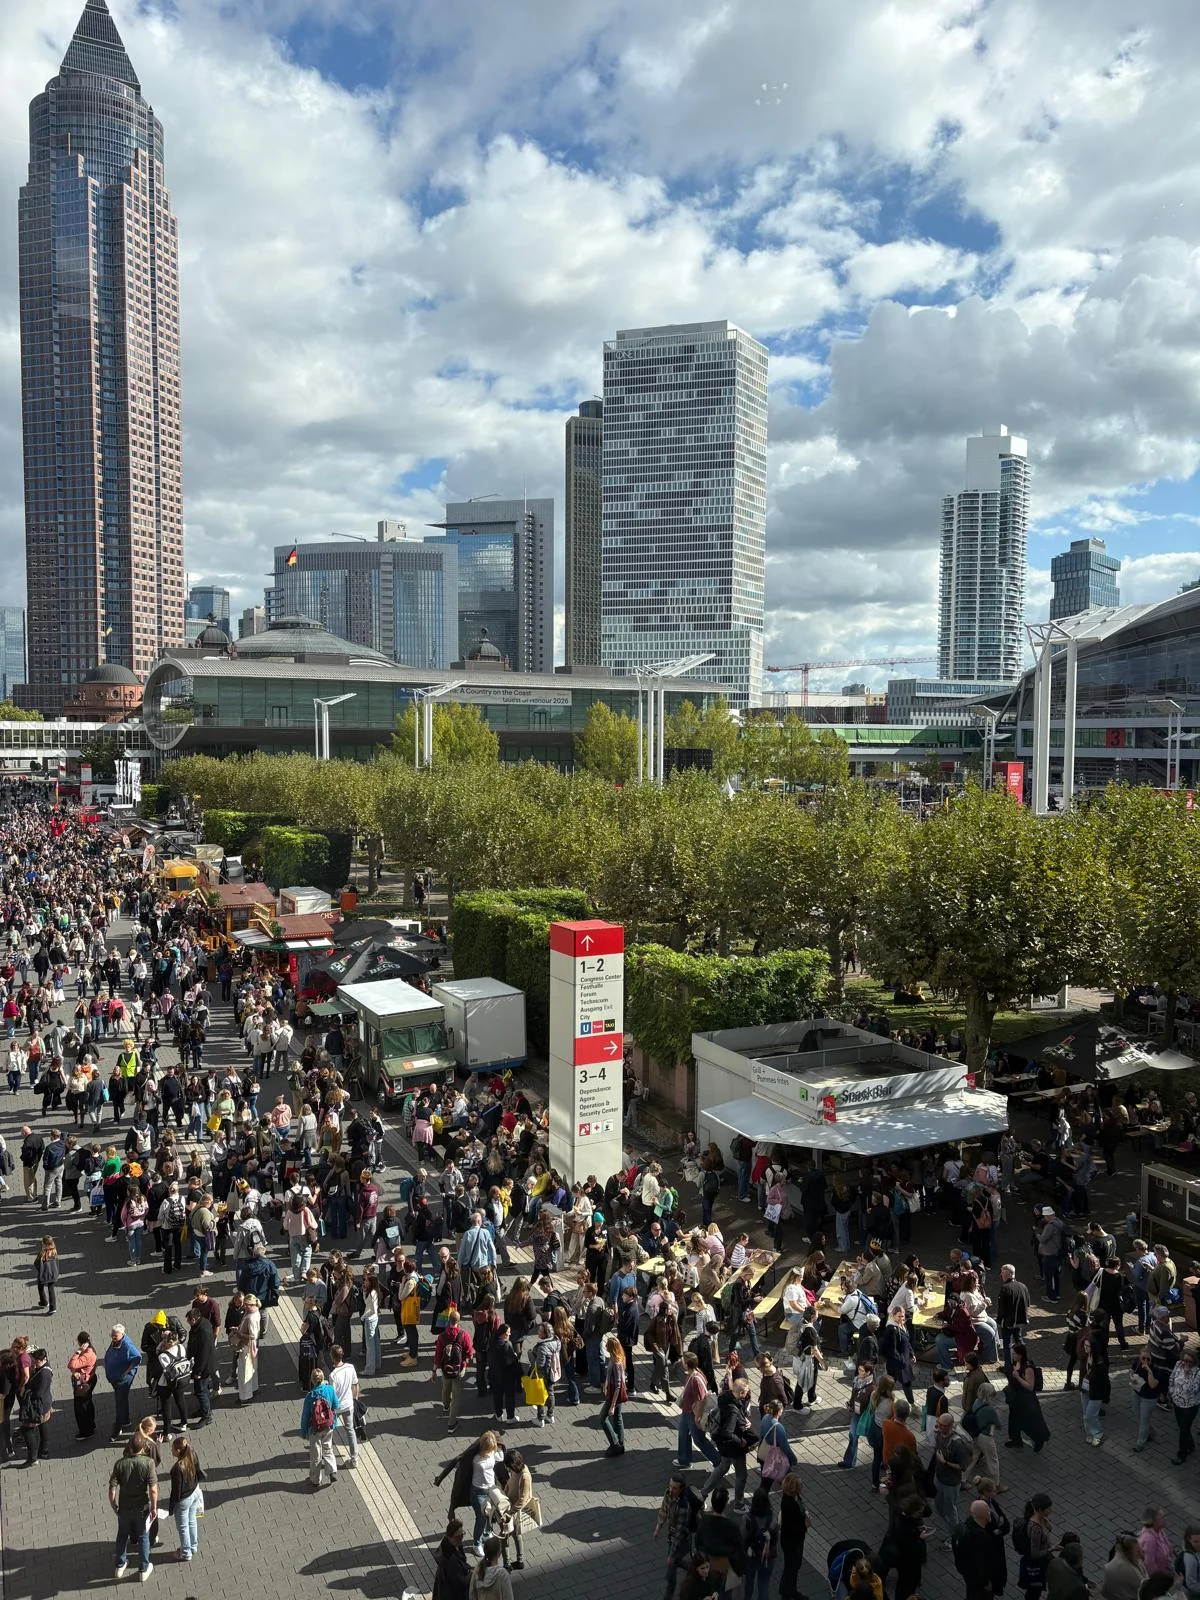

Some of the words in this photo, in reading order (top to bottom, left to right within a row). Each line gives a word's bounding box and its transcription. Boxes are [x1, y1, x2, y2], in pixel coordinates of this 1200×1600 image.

[466, 688, 492, 696] Country
[553, 697, 569, 705] 2026
[1110, 730, 1120, 746] 3
[583, 1023, 589, 1033] U
